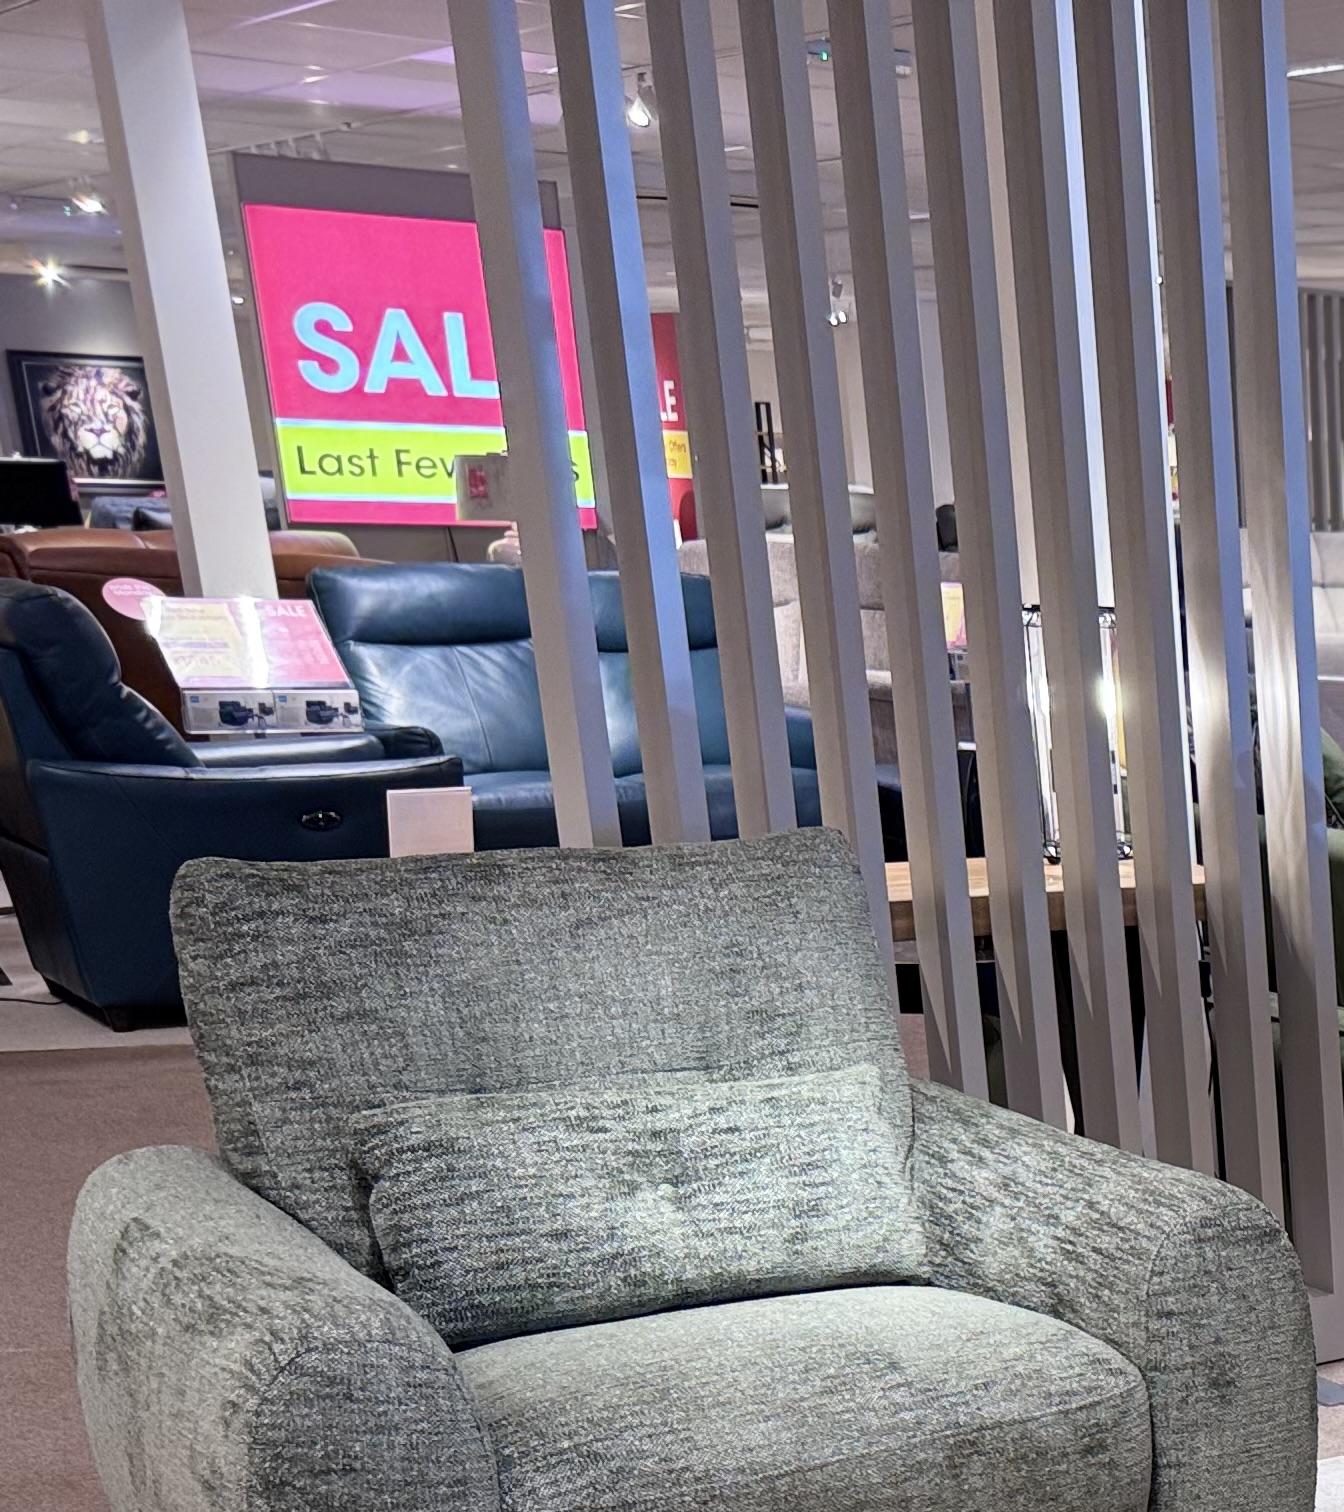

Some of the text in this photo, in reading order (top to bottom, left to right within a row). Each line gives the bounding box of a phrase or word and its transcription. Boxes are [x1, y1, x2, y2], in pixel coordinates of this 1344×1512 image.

[292, 301, 501, 400] SAL
[297, 445, 378, 477] Last
[265, 605, 306, 618] SALE
